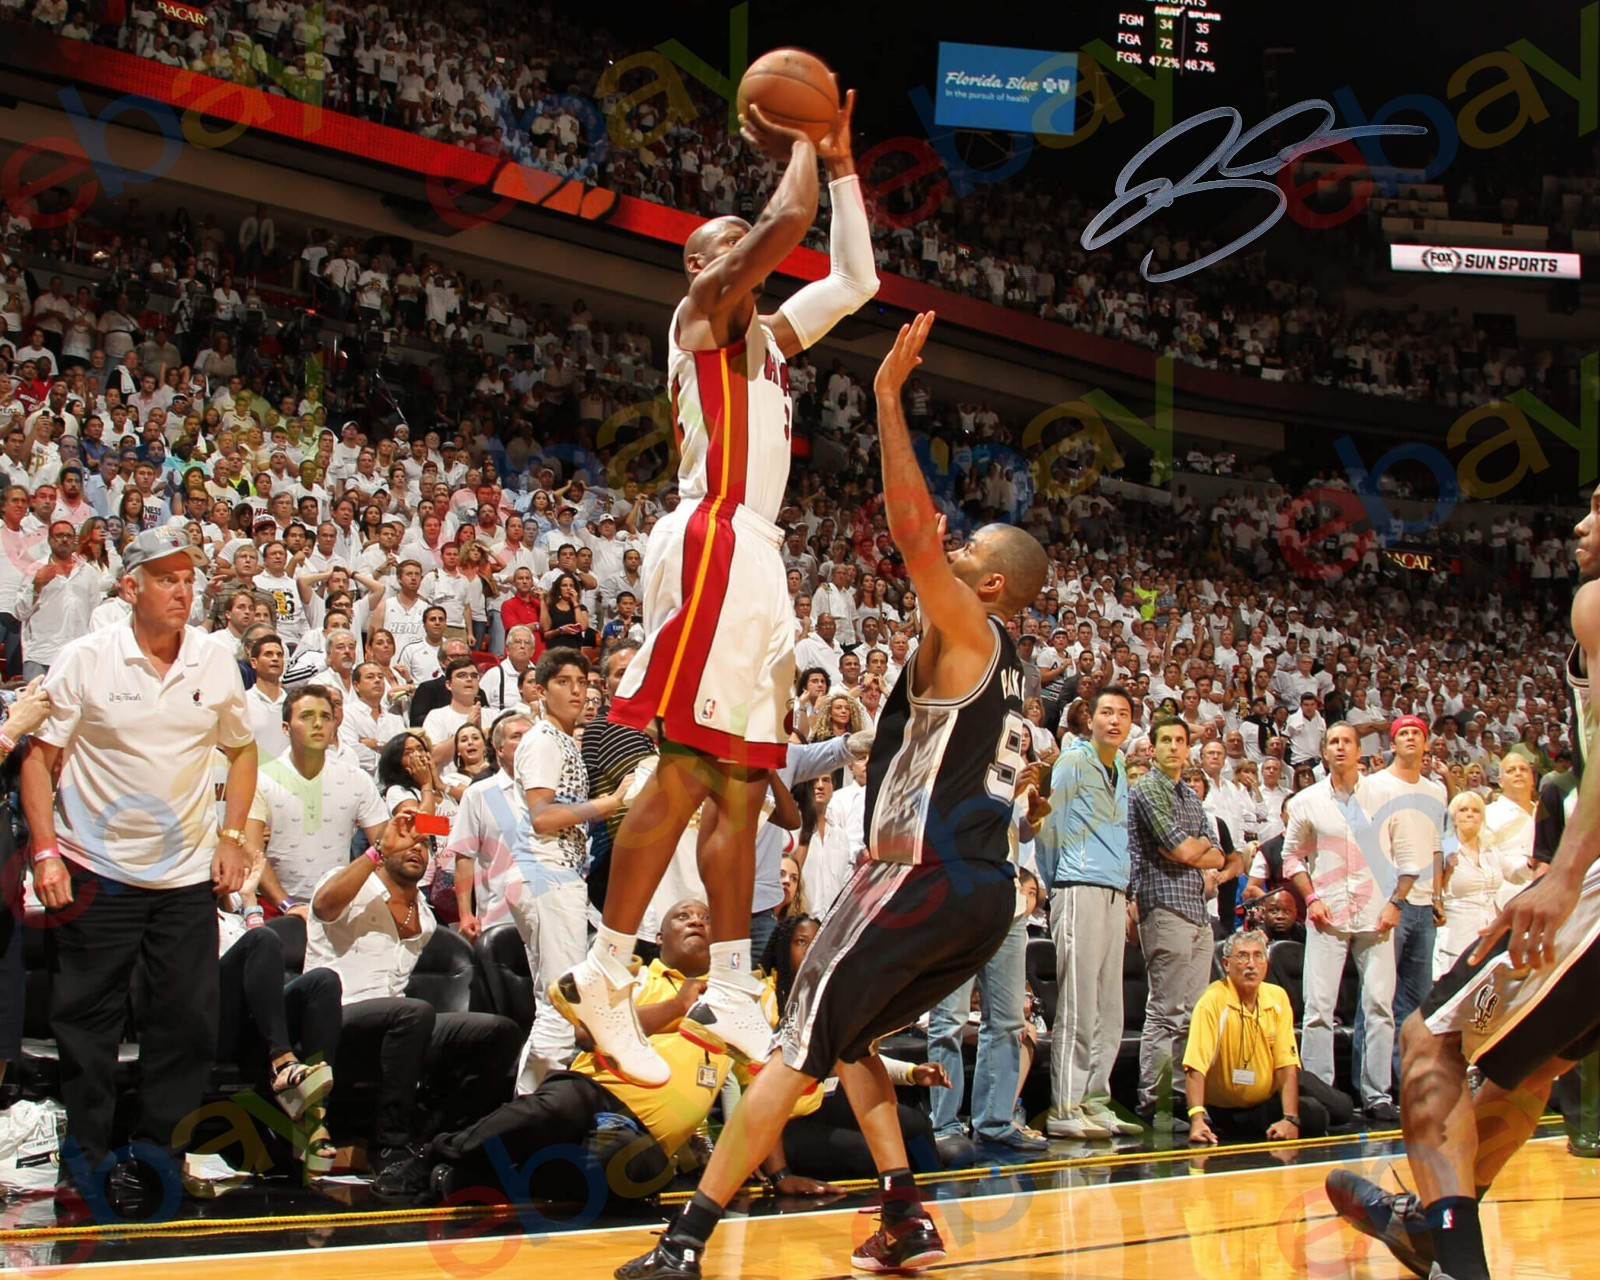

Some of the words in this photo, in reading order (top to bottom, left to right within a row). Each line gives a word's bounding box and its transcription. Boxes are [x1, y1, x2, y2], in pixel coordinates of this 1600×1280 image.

[1118, 13, 1145, 27] FGM
[1160, 19, 1174, 31] 34
[1195, 22, 1210, 35] 35
[1117, 32, 1142, 46] FGA
[1160, 37, 1174, 50] 72
[1194, 41, 1209, 54] 75
[1116, 51, 1143, 65] FG%
[1148, 55, 1181, 69] 47.2%
[1184, 59, 1217, 73] 46.7%
[944, 71, 1004, 90] Florida
[1004, 77, 1039, 92] Blue
[954, 89, 968, 98] the
[968, 91, 995, 101] pursuit
[1006, 93, 1030, 103] health
[1430, 252, 1454, 263] FOX
[1465, 253, 1497, 269] SUN
[1499, 256, 1558, 272] SPORTS
[388, 621, 420, 634] HEAT
[984, 709, 1025, 807] 9
